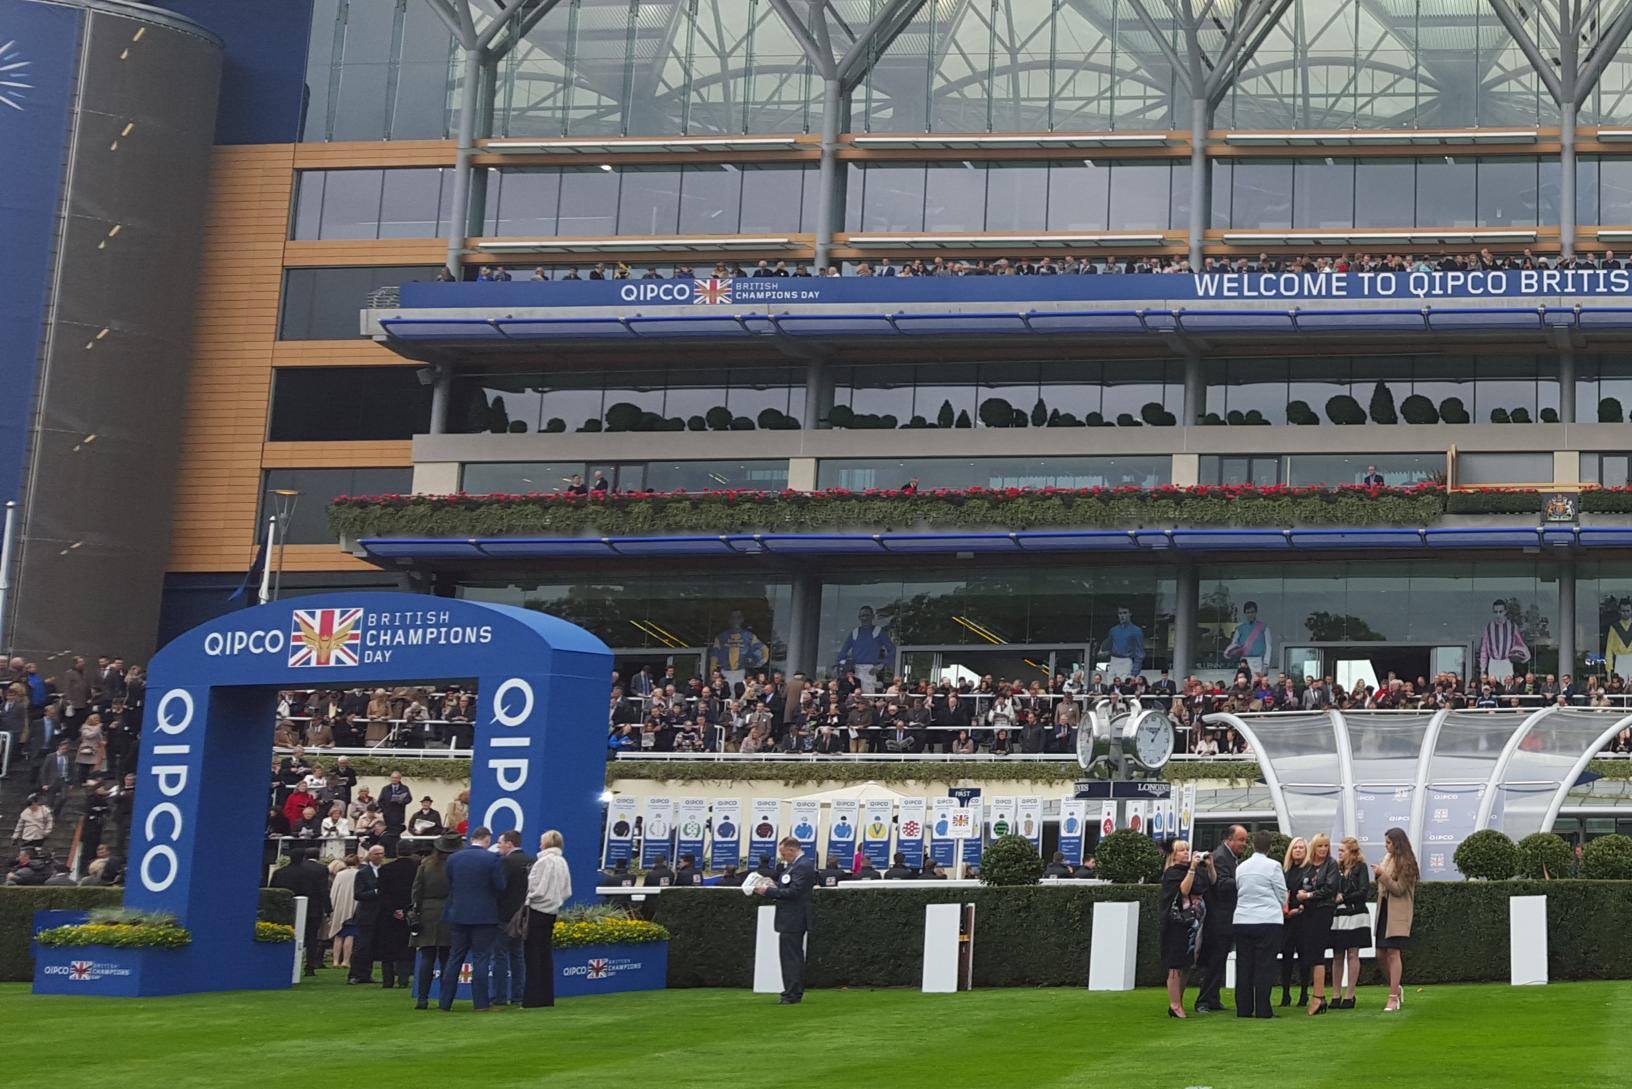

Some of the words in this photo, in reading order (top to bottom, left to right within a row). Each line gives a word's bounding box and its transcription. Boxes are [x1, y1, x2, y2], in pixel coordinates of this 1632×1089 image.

[735, 282, 779, 291] BRITISH
[1194, 272, 1349, 297] WELCOME
[1358, 272, 1397, 295] TO
[1408, 270, 1507, 298] QIPCO
[620, 283, 690, 301] QIPCO
[735, 291, 798, 300] CHAMPIONS
[801, 290, 820, 299] DAY
[367, 611, 450, 626] BRITISH
[204, 629, 285, 657] QIPCO
[366, 626, 493, 646] CHAMPIONS
[364, 650, 392, 664] DAY
[483, 677, 535, 850] QIPC
[140, 688, 194, 892] QIPCO
[1138, 783, 1170, 792] LONGINE
[44, 966, 69, 975] QIPCO
[563, 965, 587, 976] QIPCO
